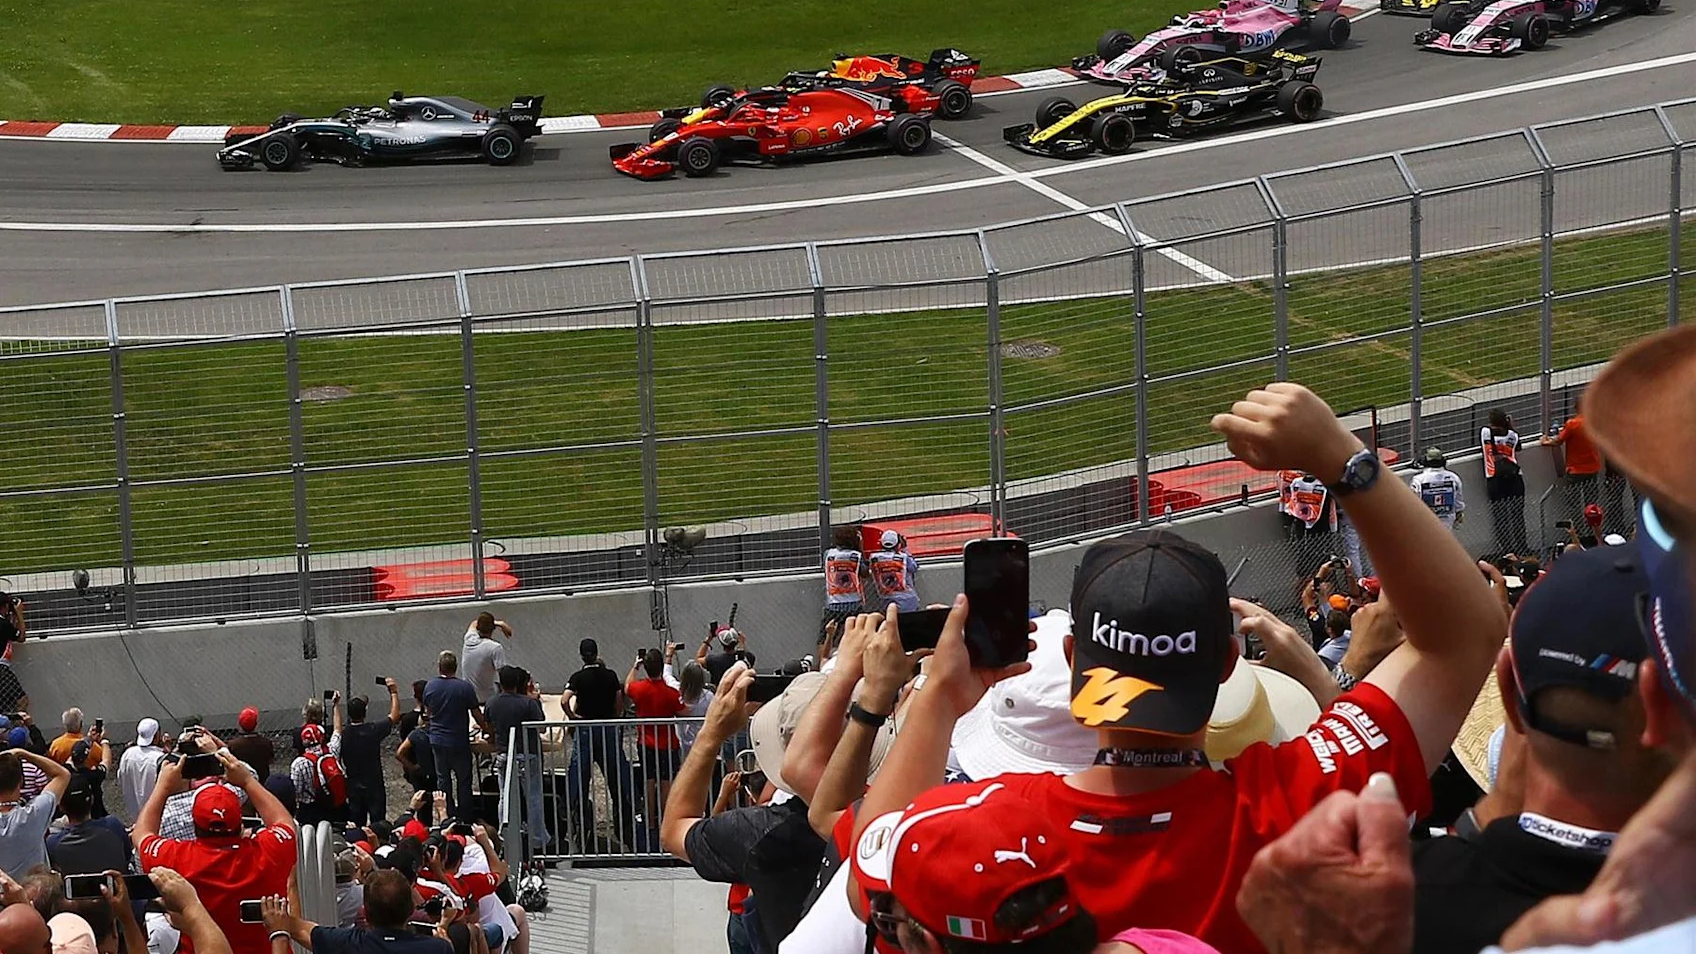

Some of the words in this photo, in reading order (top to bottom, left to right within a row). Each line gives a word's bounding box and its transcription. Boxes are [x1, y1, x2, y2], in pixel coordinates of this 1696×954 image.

[1115, 103, 1146, 113] MAPFRE
[472, 110, 491, 123] 44
[374, 134, 427, 146] PETRONAS
[1092, 612, 1196, 656] kimoa
[1539, 648, 1574, 662] powered
[1574, 654, 1586, 666] by
[1122, 749, 1183, 765] Montreal
